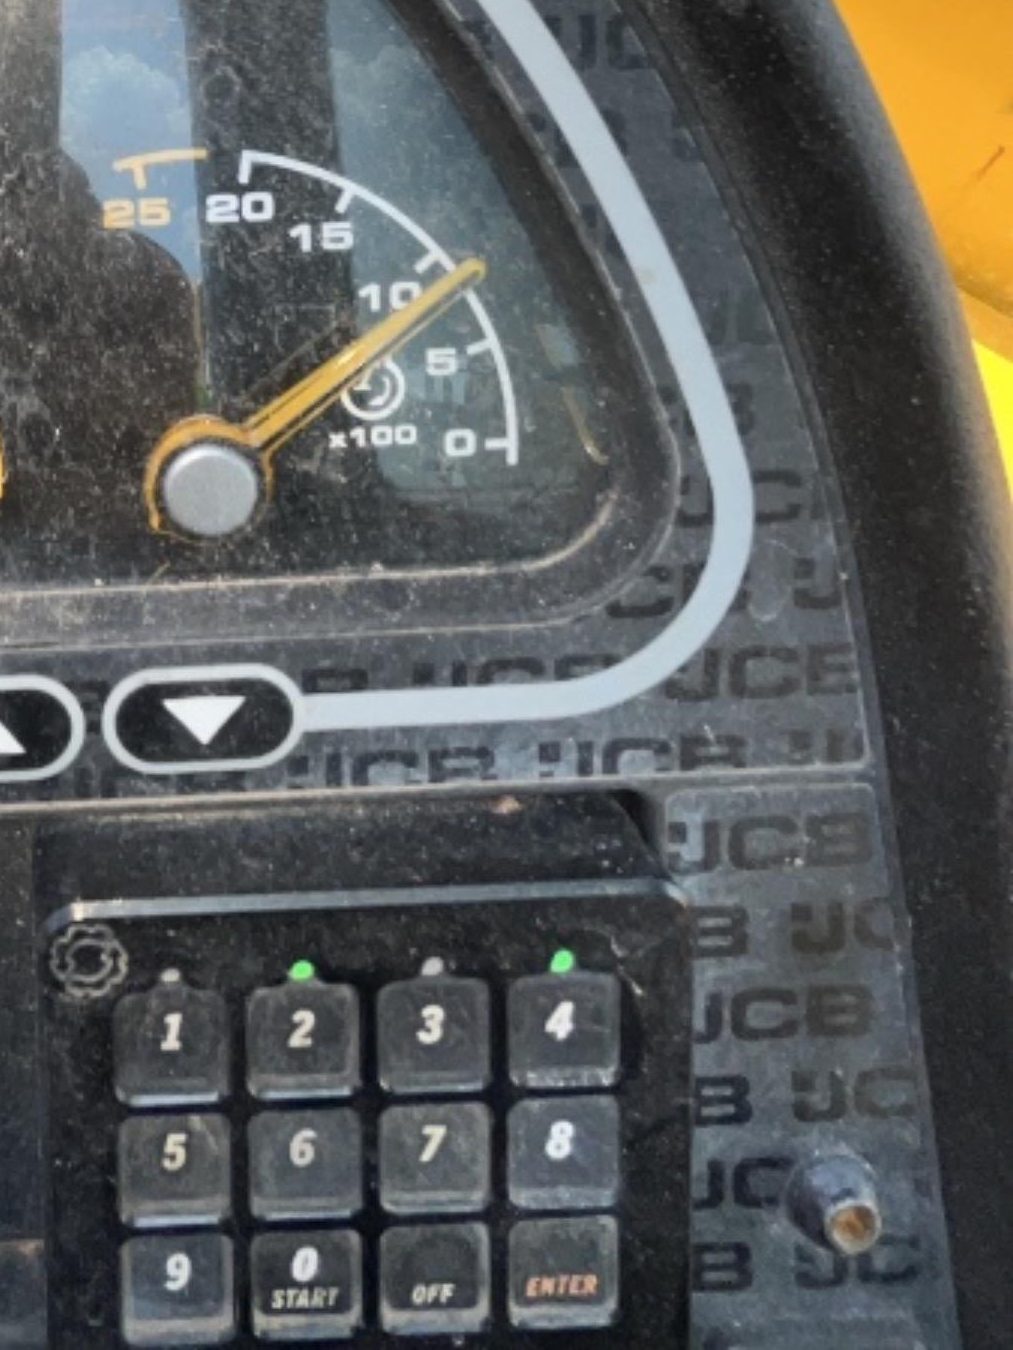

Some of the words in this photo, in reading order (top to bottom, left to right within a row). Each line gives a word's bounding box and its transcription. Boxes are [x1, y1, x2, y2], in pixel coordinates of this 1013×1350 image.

[101, 196, 172, 230] 25
[204, 190, 275, 224] 20
[289, 219, 355, 253] 15
[358, 280, 423, 313] 10
[425, 347, 459, 377] 5
[328, 423, 419, 449] x100
[443, 427, 478, 458] 0
[668, 812, 876, 875] JCB
[159, 1012, 183, 1051] 1
[288, 1008, 316, 1048] 2
[416, 1003, 446, 1044] 3
[544, 999, 575, 1042] 4
[693, 984, 873, 1045] JCB
[161, 1132, 188, 1172] 5
[289, 1127, 318, 1168] 6
[418, 1124, 448, 1163] 7
[544, 1120, 576, 1161] 8
[163, 1252, 193, 1292] 9
[291, 1245, 319, 1283] 0
[525, 1272, 599, 1298] ENTER
[270, 1286, 340, 1311] START
[410, 1282, 456, 1305] OFF
